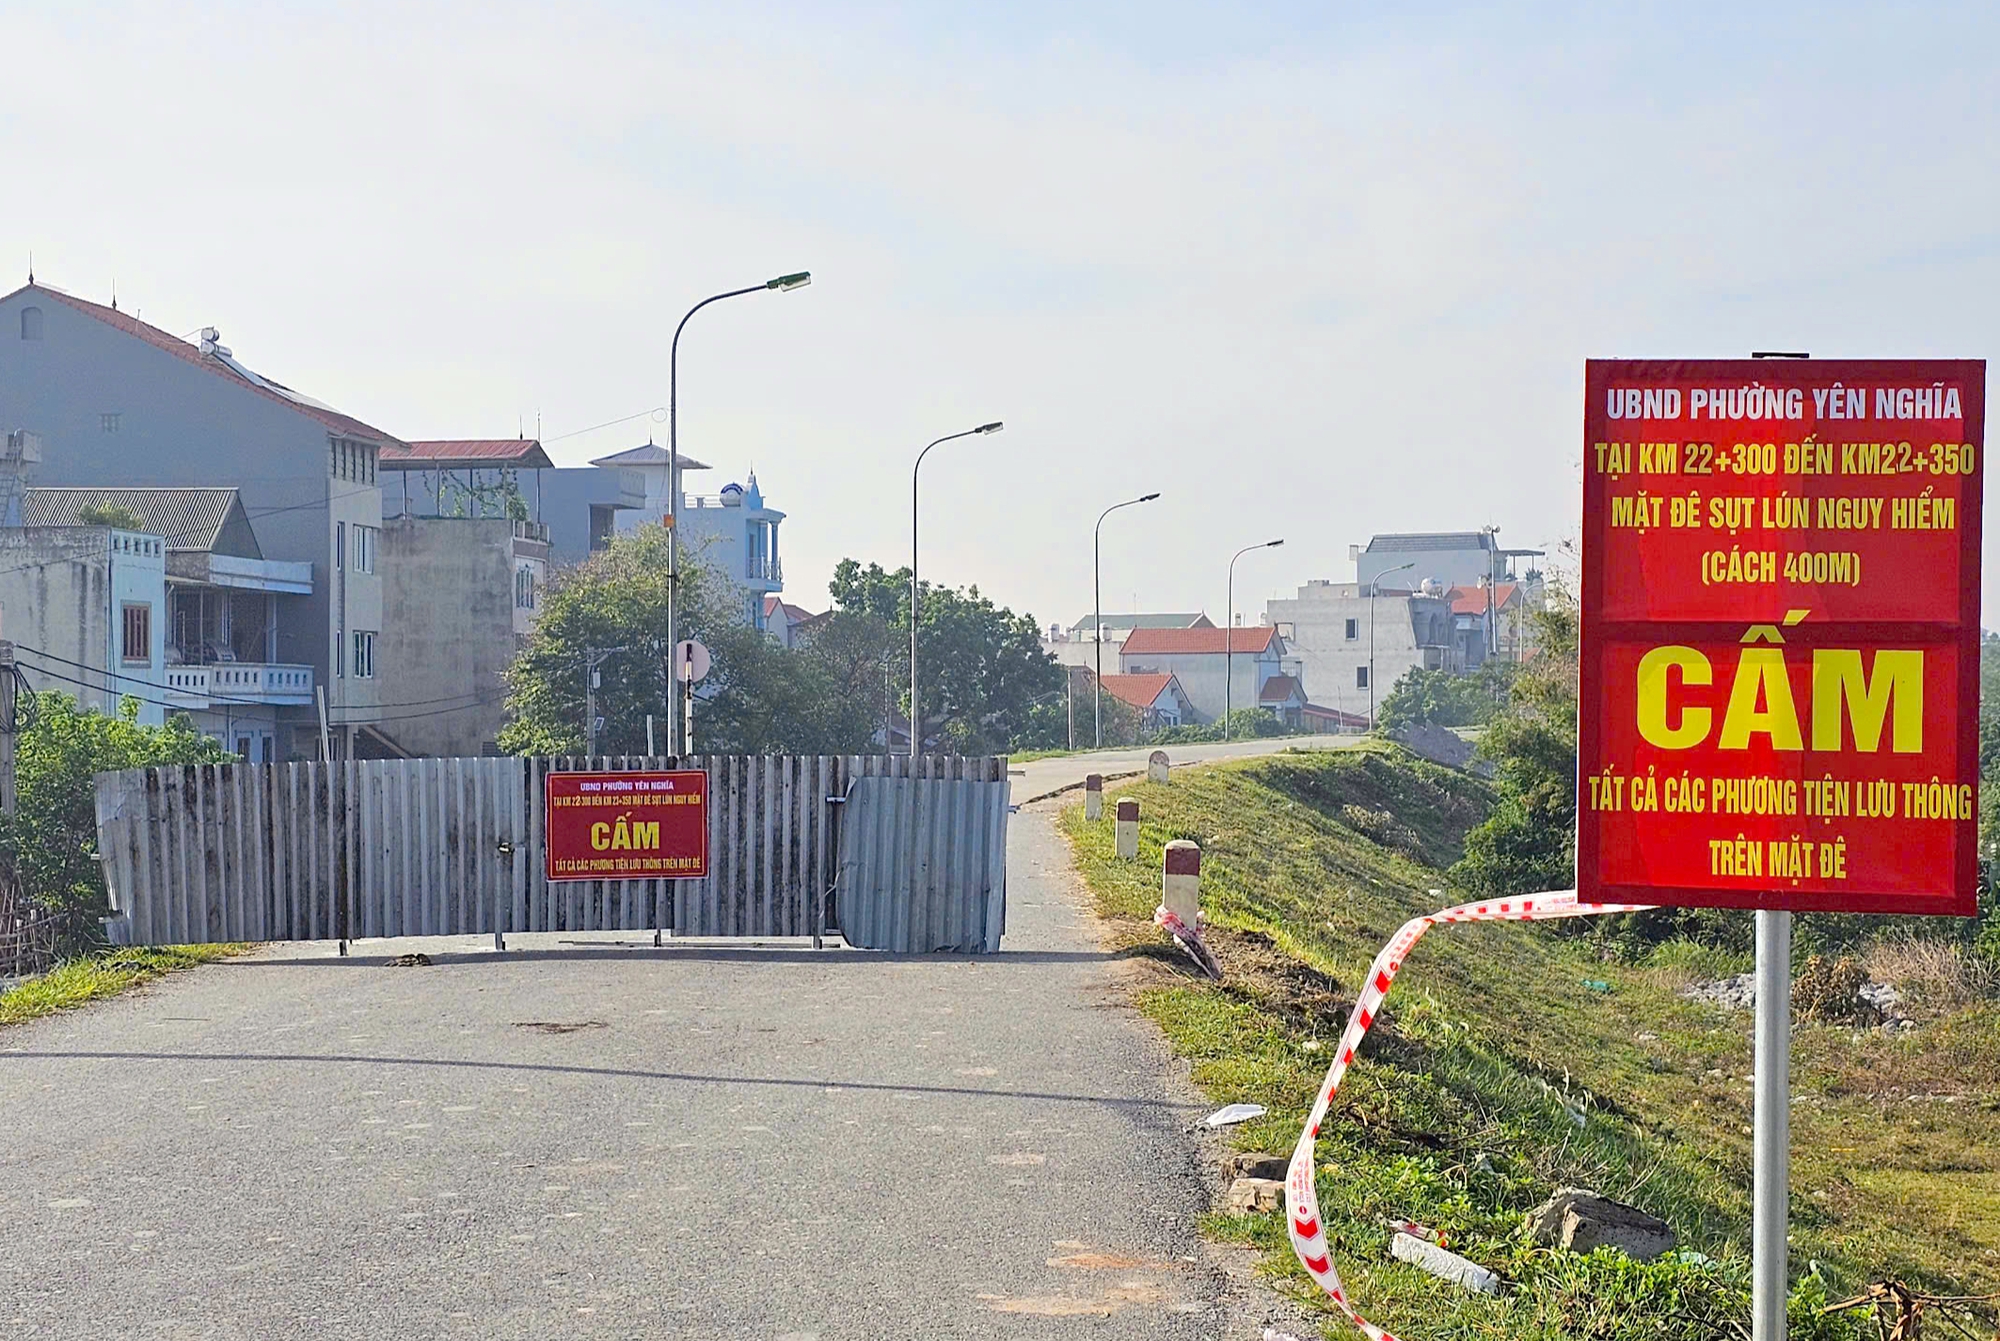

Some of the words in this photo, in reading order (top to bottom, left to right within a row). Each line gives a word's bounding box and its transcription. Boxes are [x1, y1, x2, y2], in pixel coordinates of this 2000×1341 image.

[1607, 388, 1681, 419] UBND
[1690, 382, 1802, 420] PHƯỜNG
[1813, 383, 1866, 419] YÊN
[1875, 382, 1962, 419] NGHĨA
[1595, 443, 1630, 480] TẠI
[1639, 443, 1677, 473] KM
[1684, 443, 1776, 474] 22+300
[1784, 434, 1833, 474] ĐẾN
[1841, 442, 1974, 474] KM22+350
[1611, 490, 1663, 534] MẶT
[1670, 491, 1701, 527] ĐÊ
[1709, 498, 1755, 535] SỤT
[1762, 491, 1809, 528] LÚN
[1818, 499, 1884, 529] NGUY
[1891, 485, 1955, 529] HIỂM
[1701, 545, 1776, 586] (CÁCH
[1784, 552, 1860, 586] 400M)
[1637, 609, 1924, 753] CẤM
[580, 783, 601, 791] UBND
[1589, 764, 1624, 811] TẤT
[1631, 766, 1657, 812] CẢ
[1664, 769, 1705, 813] CÁC
[1712, 777, 1796, 815] PHƯƠNG
[1803, 774, 1849, 824] TIỆN
[1857, 778, 1895, 818] LƯU
[1902, 776, 1972, 820] THÔNG
[591, 811, 660, 850] CẤM
[1709, 833, 1762, 876] TRÊN
[1769, 835, 1814, 885] MẶT
[1820, 836, 1846, 879] ĐÊ
